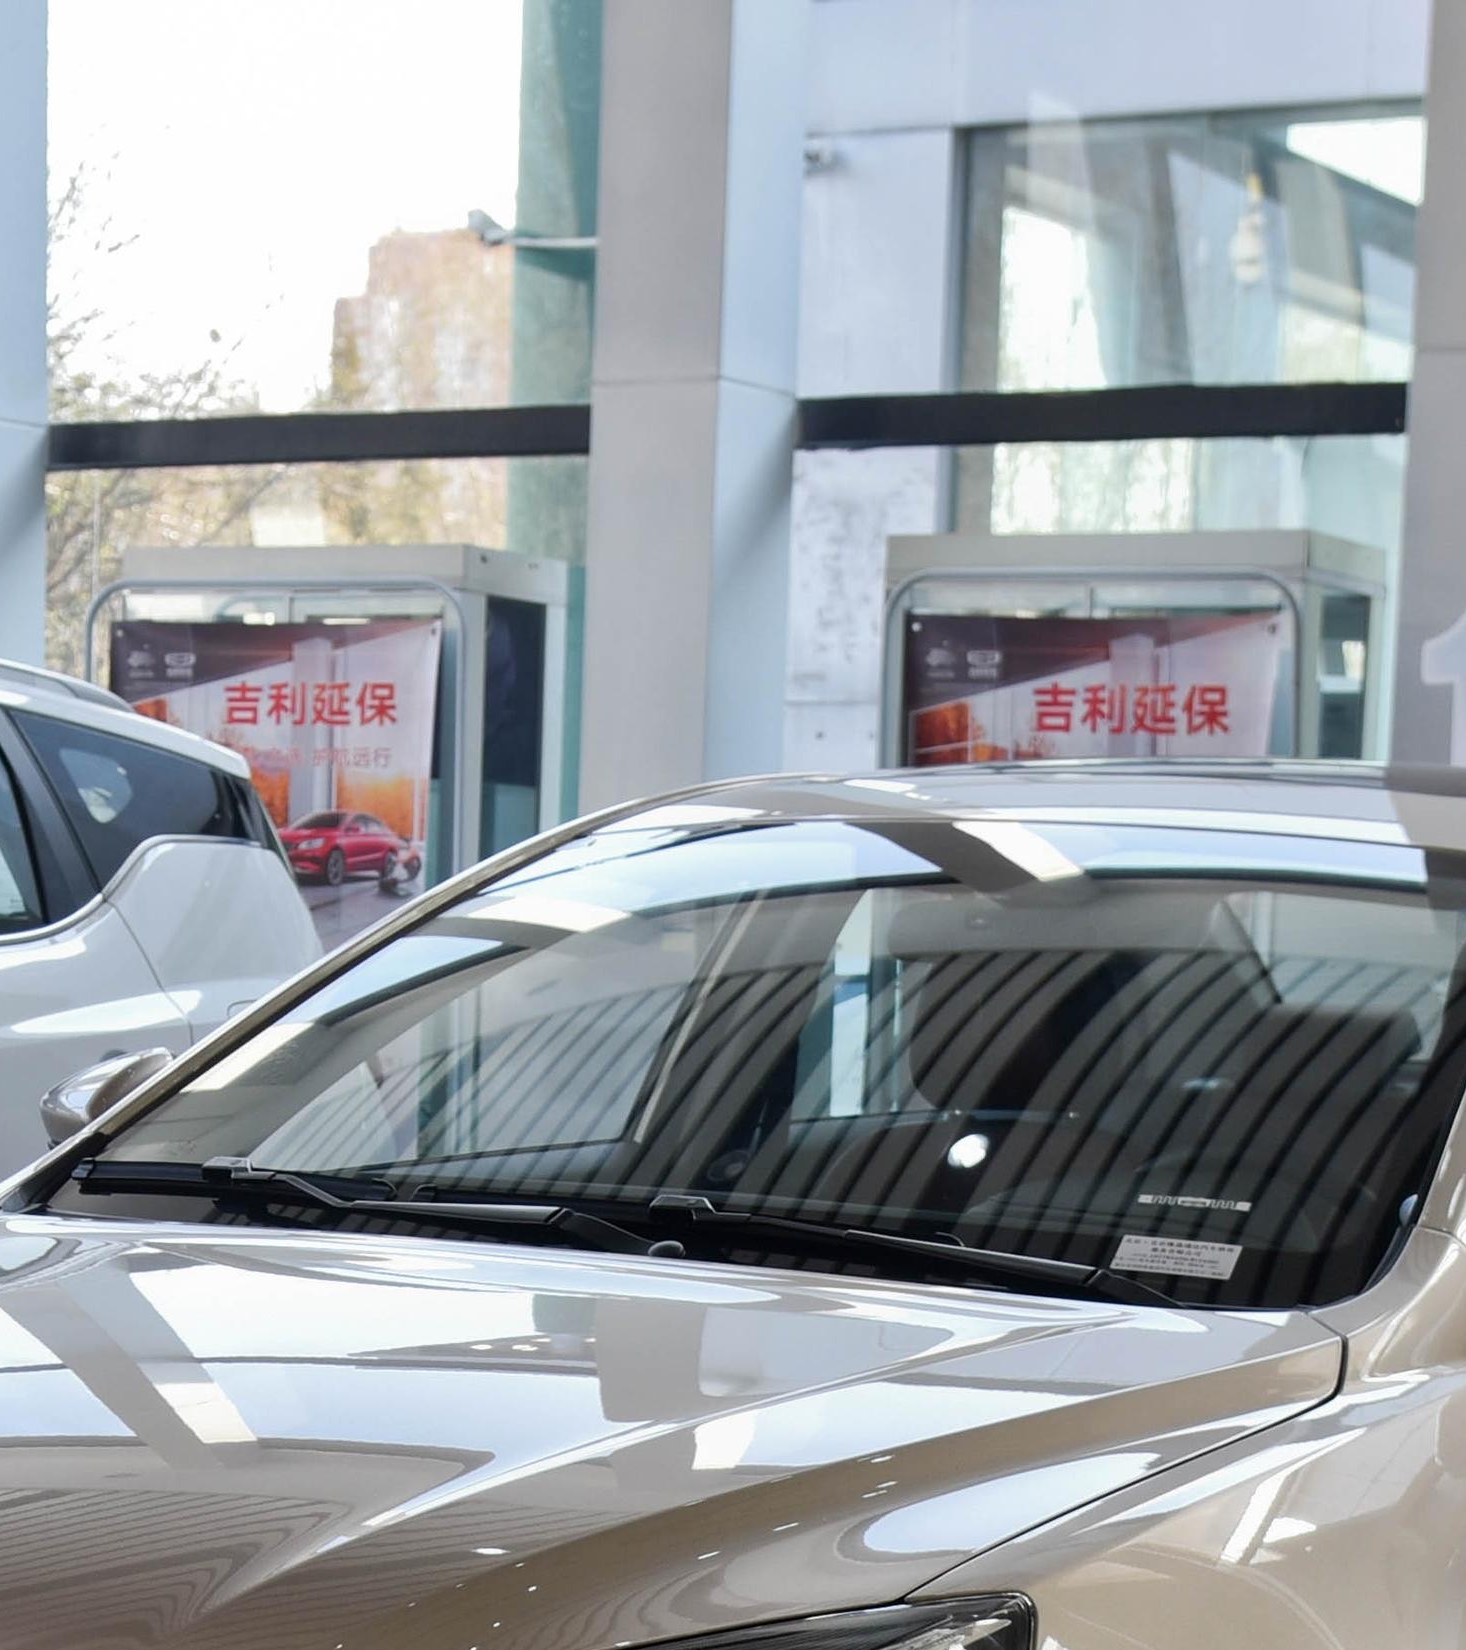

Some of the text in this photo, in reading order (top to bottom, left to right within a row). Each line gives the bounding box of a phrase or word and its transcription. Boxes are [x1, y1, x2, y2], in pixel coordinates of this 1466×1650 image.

[223, 681, 398, 727] 吉利延保
[1033, 682, 1231, 736] 吉利延保
